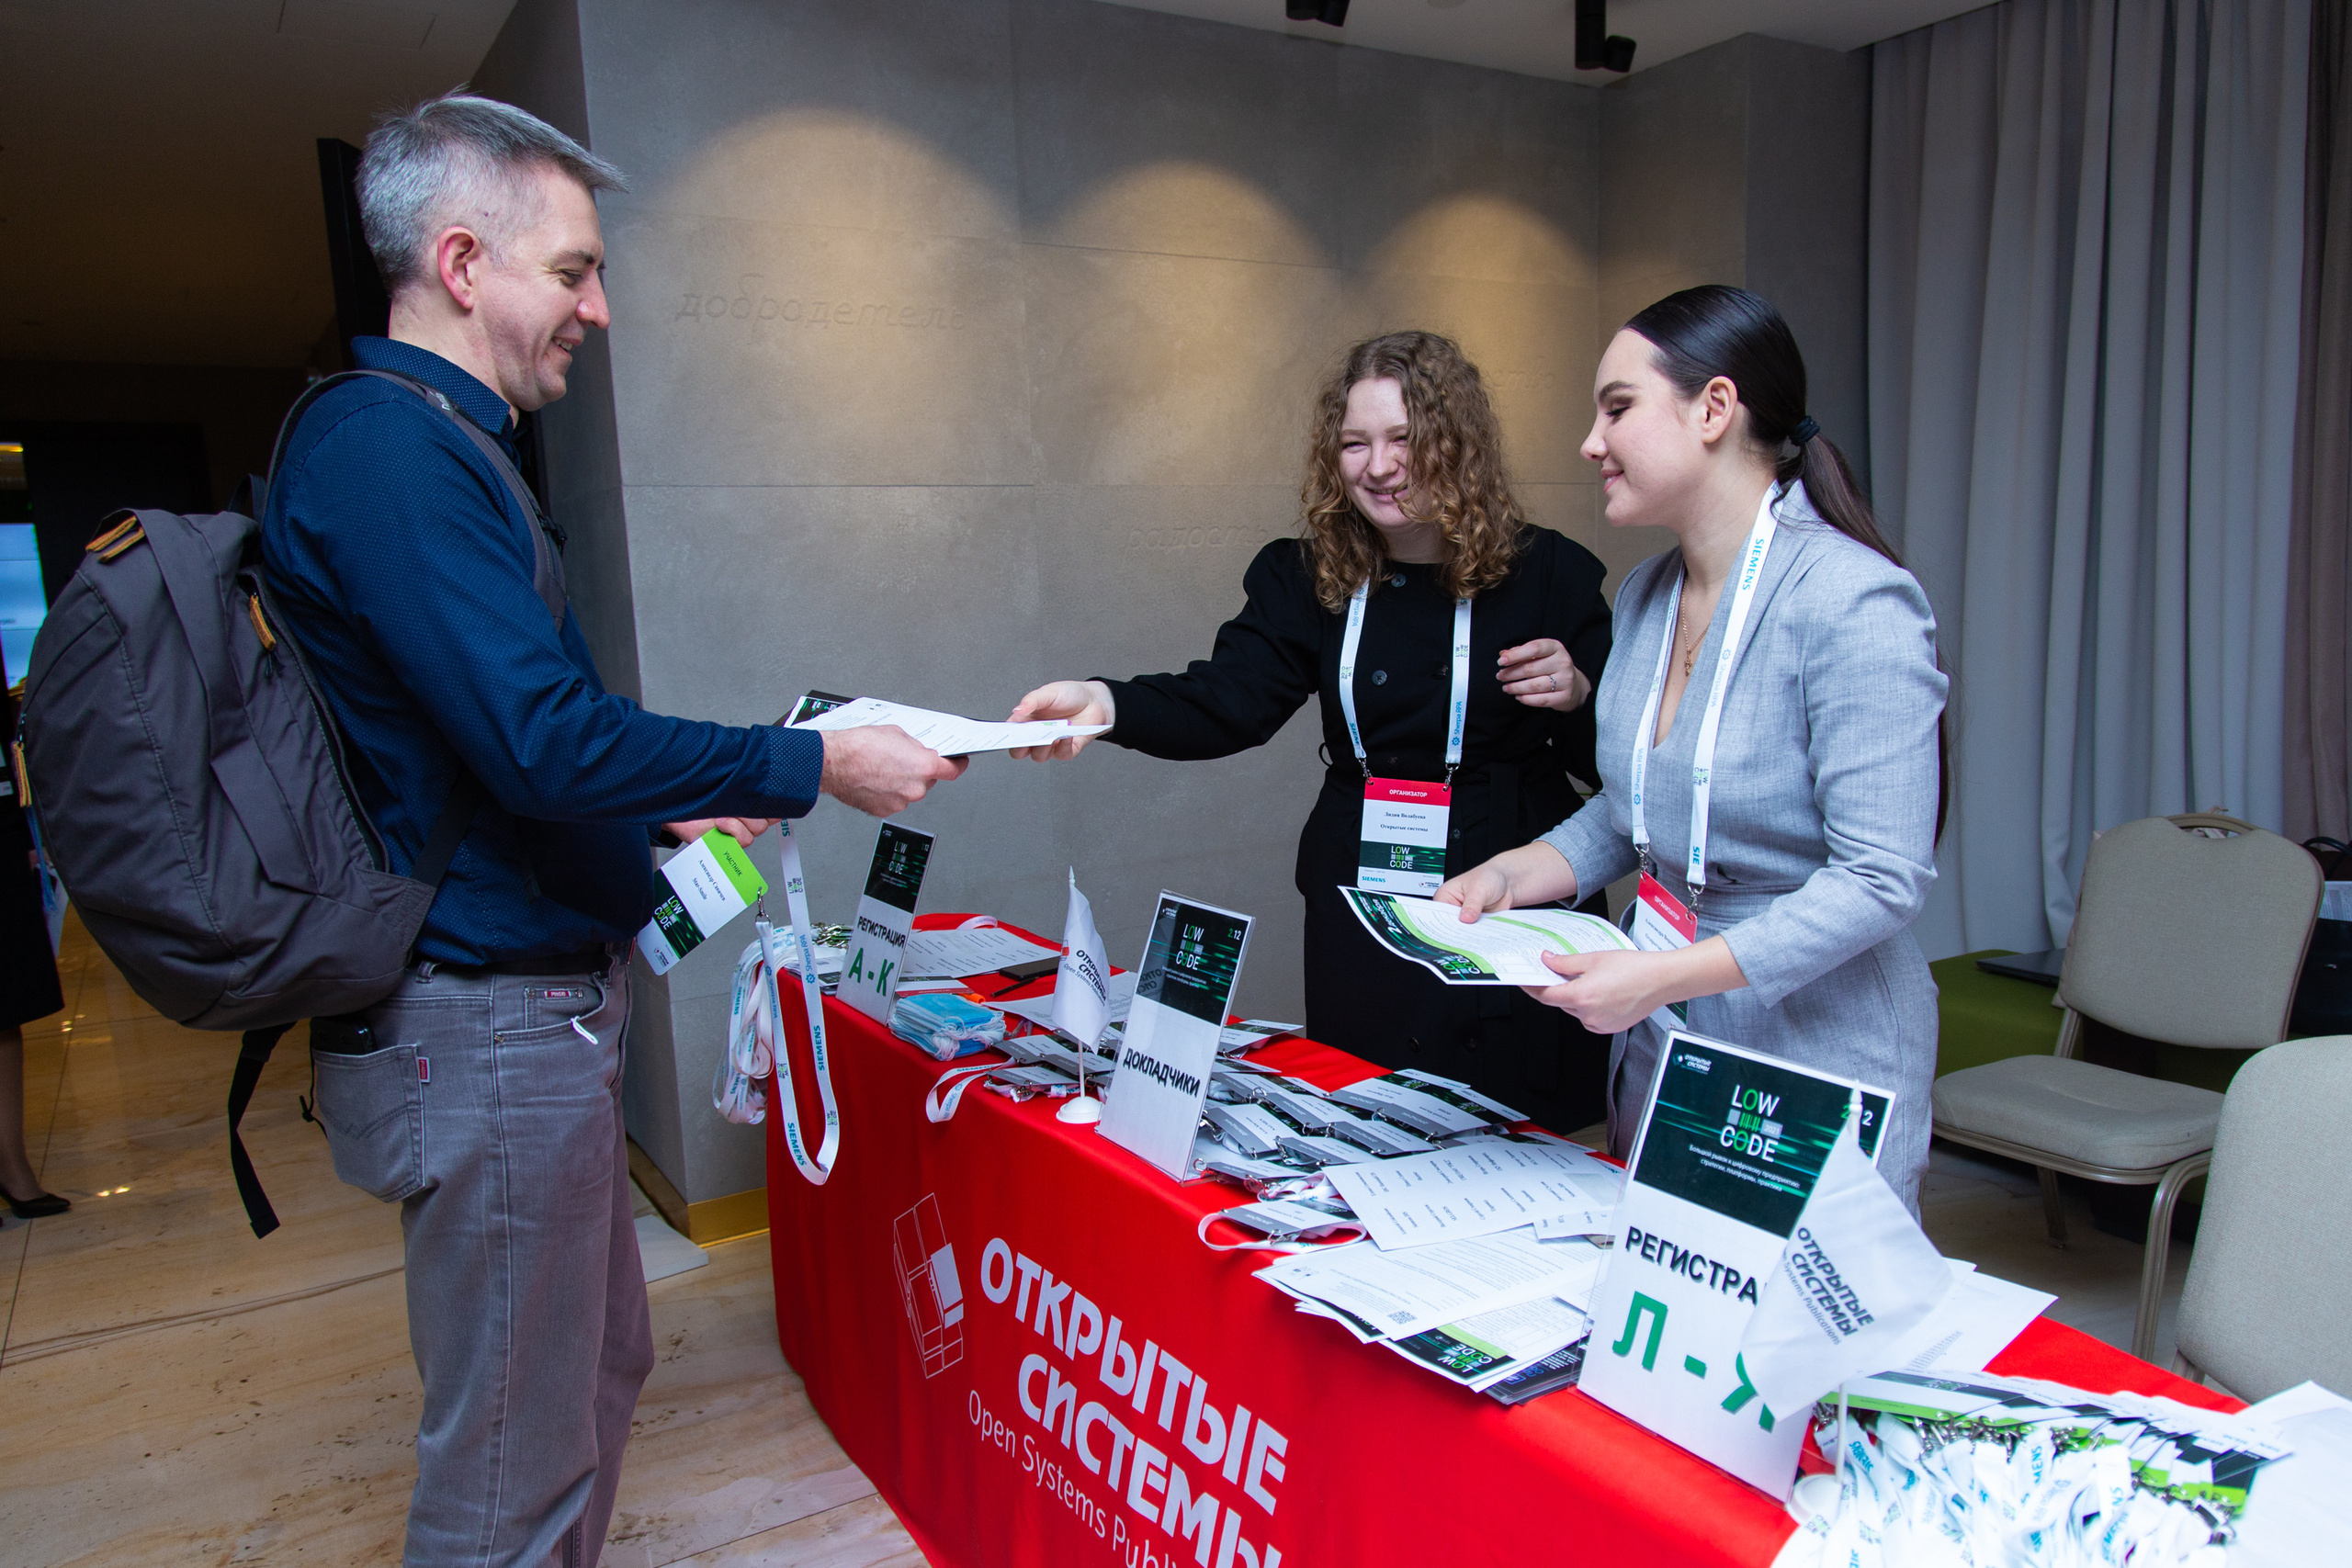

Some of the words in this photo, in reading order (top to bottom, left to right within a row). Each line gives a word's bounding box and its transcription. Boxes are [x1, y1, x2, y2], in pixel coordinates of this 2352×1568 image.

[674, 273, 967, 341] добродетель
[1742, 538, 1764, 591] SIEMENS
[1715, 663, 1726, 693] Sherpa
[1453, 713, 1462, 735] Sherpa
[1636, 748, 1645, 762] RPA
[1634, 763, 1643, 791] Sherpa
[1389, 789, 1428, 797] ОРГАНИЗАТОР
[894, 840, 908, 855] LOW
[1391, 846, 1409, 855] LOW
[723, 851, 743, 877] УЧАСТНИК
[888, 861, 904, 874] CODE
[1390, 860, 1413, 870] CODE
[692, 877, 707, 900] Star-Smile
[1362, 875, 1386, 884] SIEMENS
[667, 895, 684, 915] LOW
[654, 907, 673, 931] CODE
[799, 934, 808, 948] RPA
[857, 916, 906, 949] РЕГИСТРАЦИЯ
[1182, 923, 1204, 942] LOW
[802, 948, 813, 971] Sherpa
[1176, 951, 1201, 970] CODE
[1433, 957, 1461, 975] LOW
[1063, 964, 1076, 976] Open
[1075, 970, 1091, 988] Systems
[1079, 964, 1107, 1002] СИСТЕМЫ
[734, 987, 742, 1015] SIEMENS
[813, 1025, 825, 1071] SIEMENS
[1684, 1054, 1712, 1066] ОТКРЫТЫЕ
[1123, 1047, 1201, 1099] ДОКЛАДЧИКИ
[1687, 1061, 1711, 1072] СИСТЕМЫ
[947, 1092, 957, 1111] Sherpa
[1731, 1084, 1781, 1117] LOW
[1764, 1123, 1781, 1135] 2021
[787, 1122, 807, 1167] SIEMENS
[1720, 1124, 1779, 1163] CODE
[1689, 1145, 1713, 1158] Большой
[1712, 1152, 1728, 1164] рывок
[1732, 1158, 1762, 1177] цифровому
[1761, 1169, 1801, 1190] предприятию:
[1700, 1158, 1726, 1173] стратегии,
[1726, 1167, 1758, 1184] платформы,
[1757, 1177, 1782, 1193] практика
[1625, 1225, 1763, 1307] РЕГИСТРА
[1797, 1227, 1875, 1326] ОТКРЫТЫЕ
[1783, 1262, 1806, 1297] Systems
[1804, 1297, 1841, 1346] Publications
[1792, 1253, 1859, 1337] СИСТЕМЫ
[1437, 1355, 1474, 1373] LOW
[1451, 1343, 1493, 1364] CODE
[980, 1237, 1288, 1517] ОТКРЫТЫЕ
[969, 1389, 1016, 1458] Open
[1022, 1434, 1106, 1539] Systems
[1018, 1353, 1283, 1568] СИСТЕМЫ
